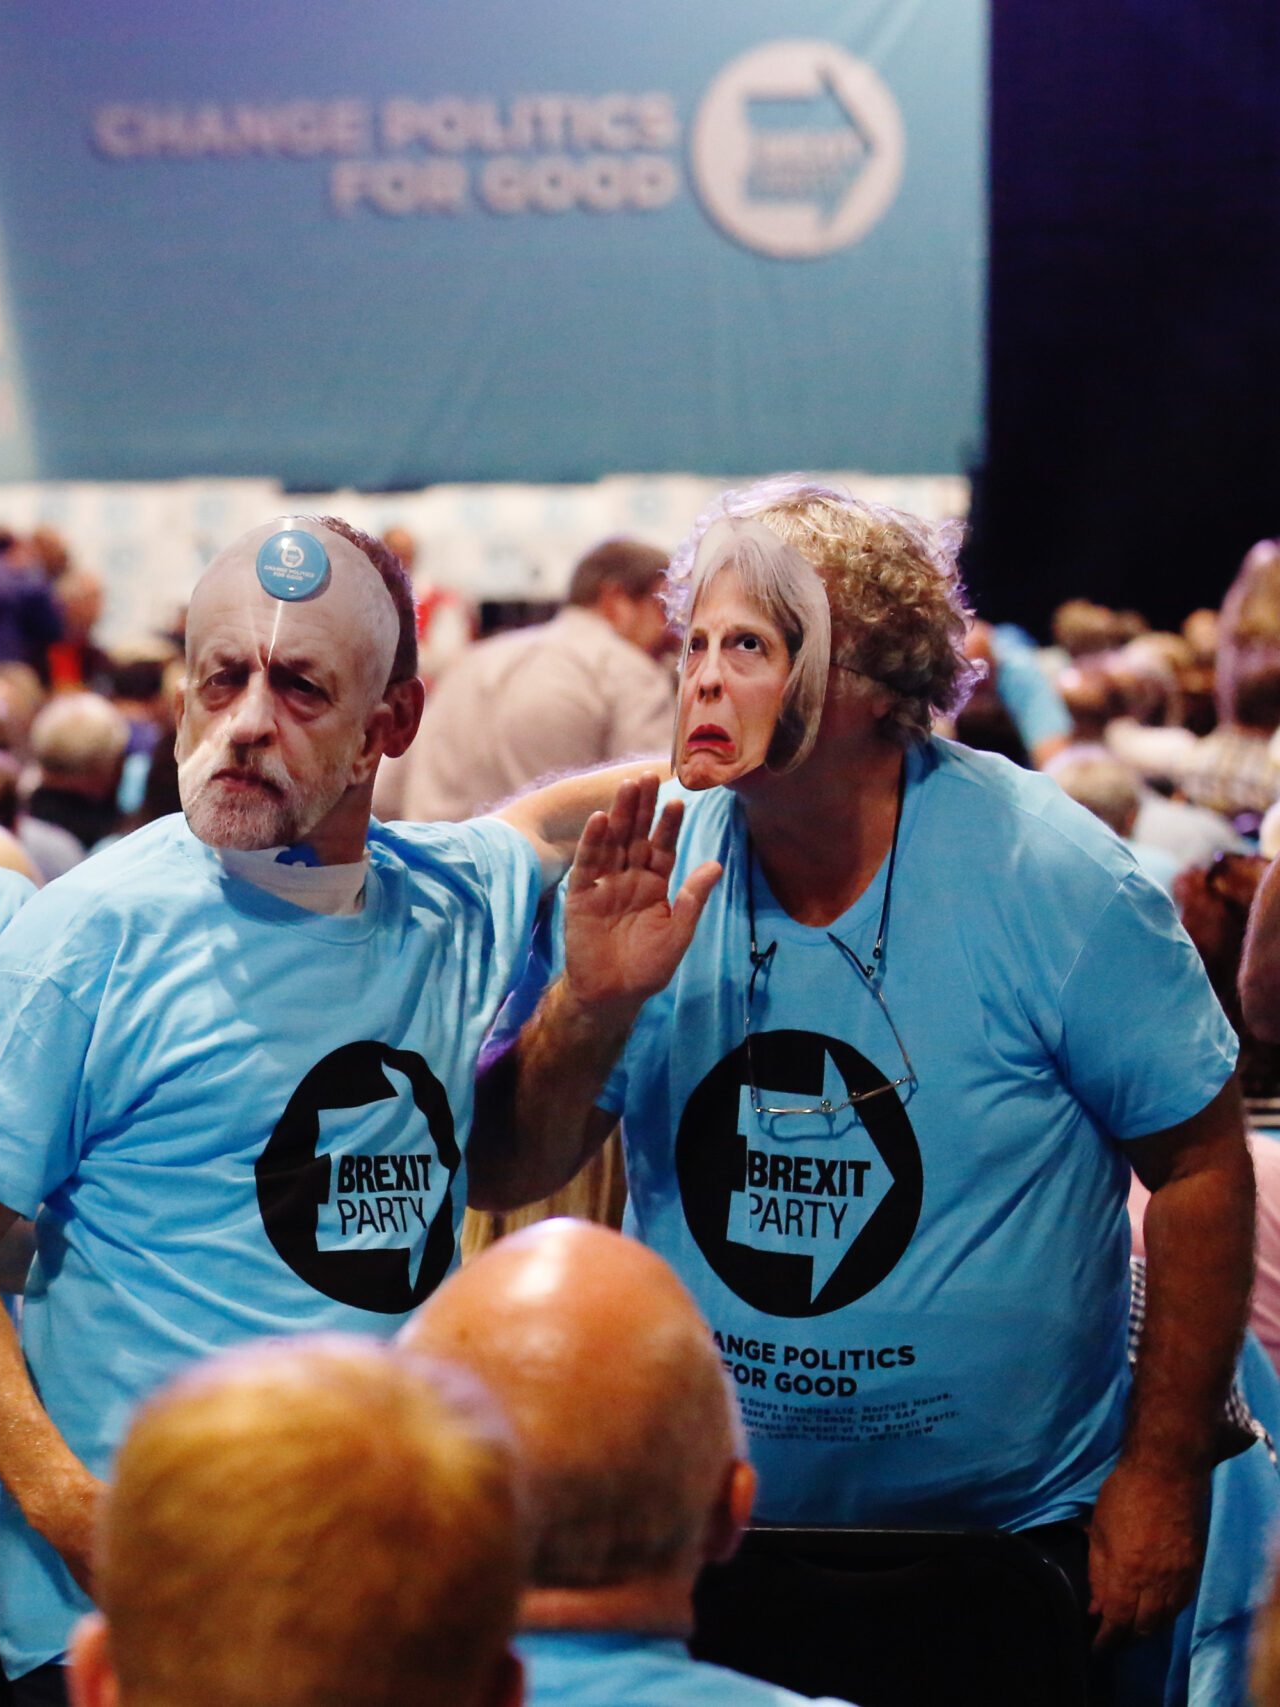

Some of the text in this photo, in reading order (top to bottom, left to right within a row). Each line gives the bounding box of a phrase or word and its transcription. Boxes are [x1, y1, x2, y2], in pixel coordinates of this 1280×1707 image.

[93, 92, 677, 158] CHANGE POLITICS
[332, 155, 678, 215] FOR GOOD
[337, 1154, 431, 1193] BREXIT
[748, 1150, 871, 1197] BREXIT
[337, 1196, 428, 1235] PARTY
[749, 1193, 848, 1239] PARTY
[713, 1330, 915, 1370] ANGE POLITICS
[774, 1372, 857, 1397] GOOD
